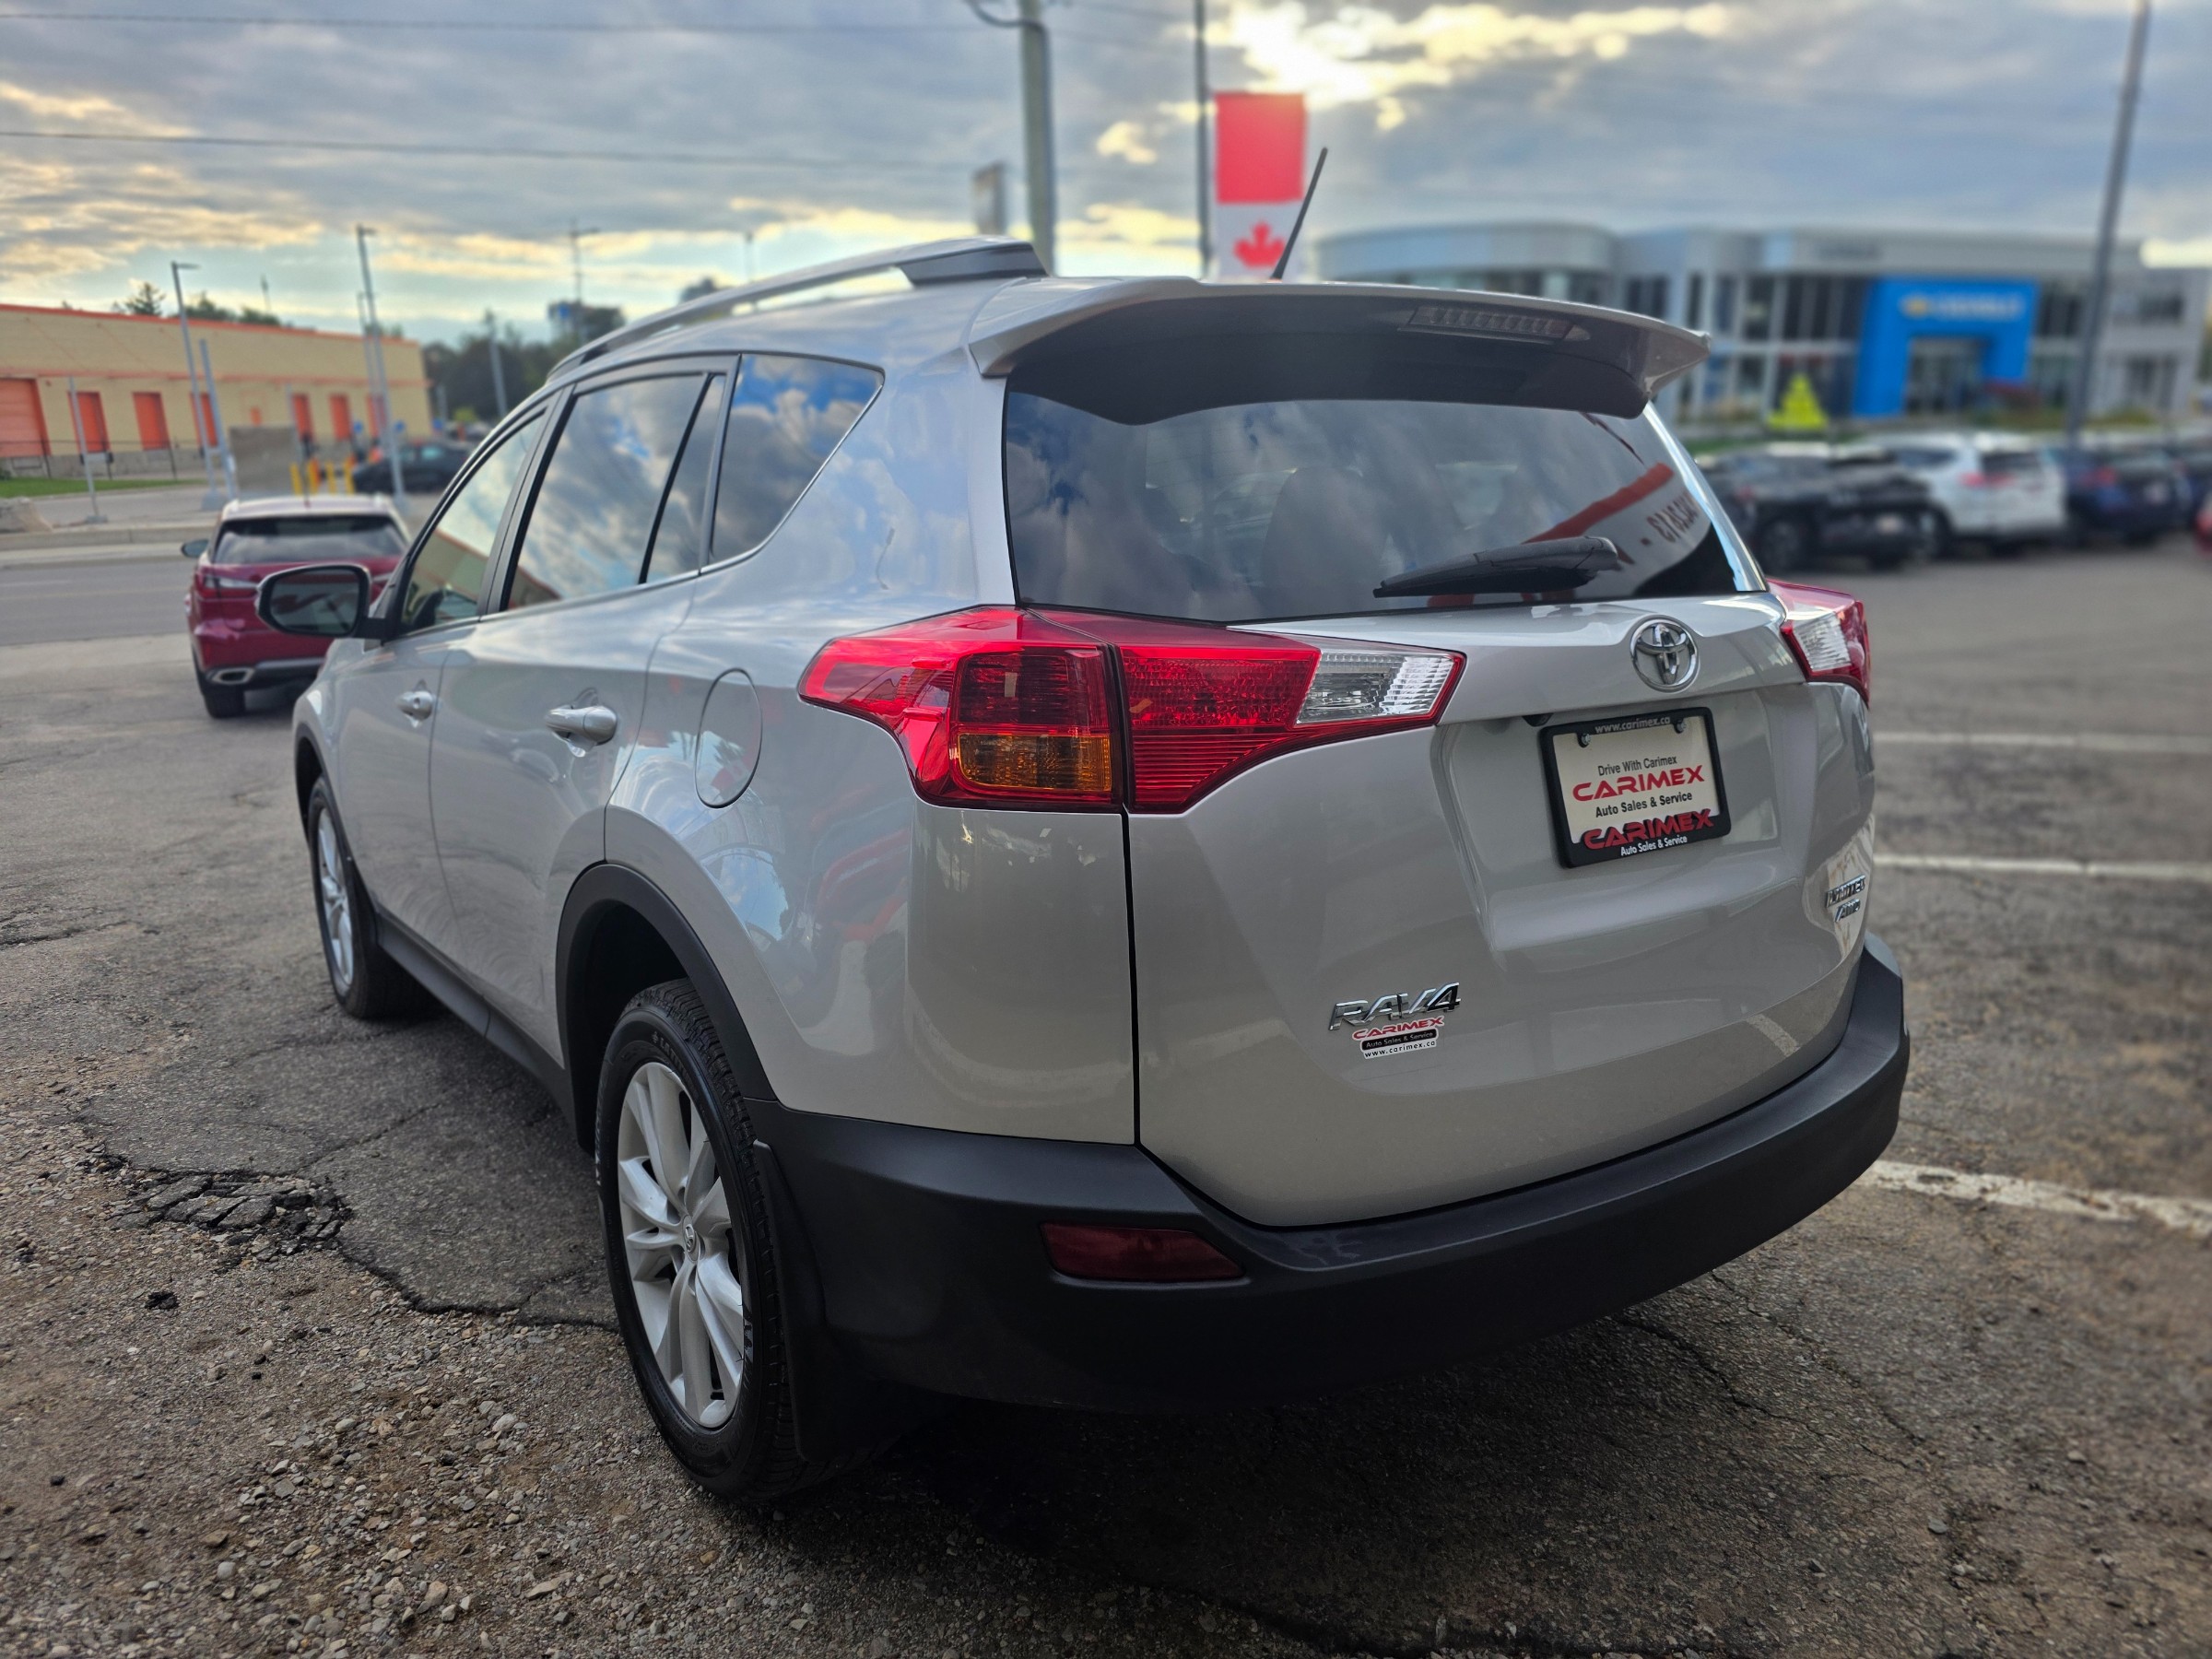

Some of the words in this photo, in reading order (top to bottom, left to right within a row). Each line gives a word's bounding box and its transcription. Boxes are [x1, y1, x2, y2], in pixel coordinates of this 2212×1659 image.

[1594, 716, 1671, 734] www.carimex.ca
[1597, 764, 1621, 776] Drive
[1622, 759, 1642, 772] With
[1643, 756, 1677, 769] Carimex
[1572, 765, 1705, 801] CARIMEX
[1595, 806, 1618, 818] Auto
[1621, 800, 1648, 813] Sales
[1651, 796, 1657, 807] &
[1660, 791, 1693, 806] Service
[1583, 808, 1714, 850] CARIMEX
[1620, 843, 1638, 856] Auto
[1638, 840, 1657, 853] Sales
[1658, 839, 1665, 848] &
[1664, 834, 1688, 847] Service
[1328, 982, 1462, 1030] RAV4
[1353, 1017, 1443, 1039] CARIMEX
[1383, 1037, 1401, 1045] Sales
[1409, 1031, 1434, 1041] Service
[1364, 1041, 1436, 1058] www.carimex.ca
